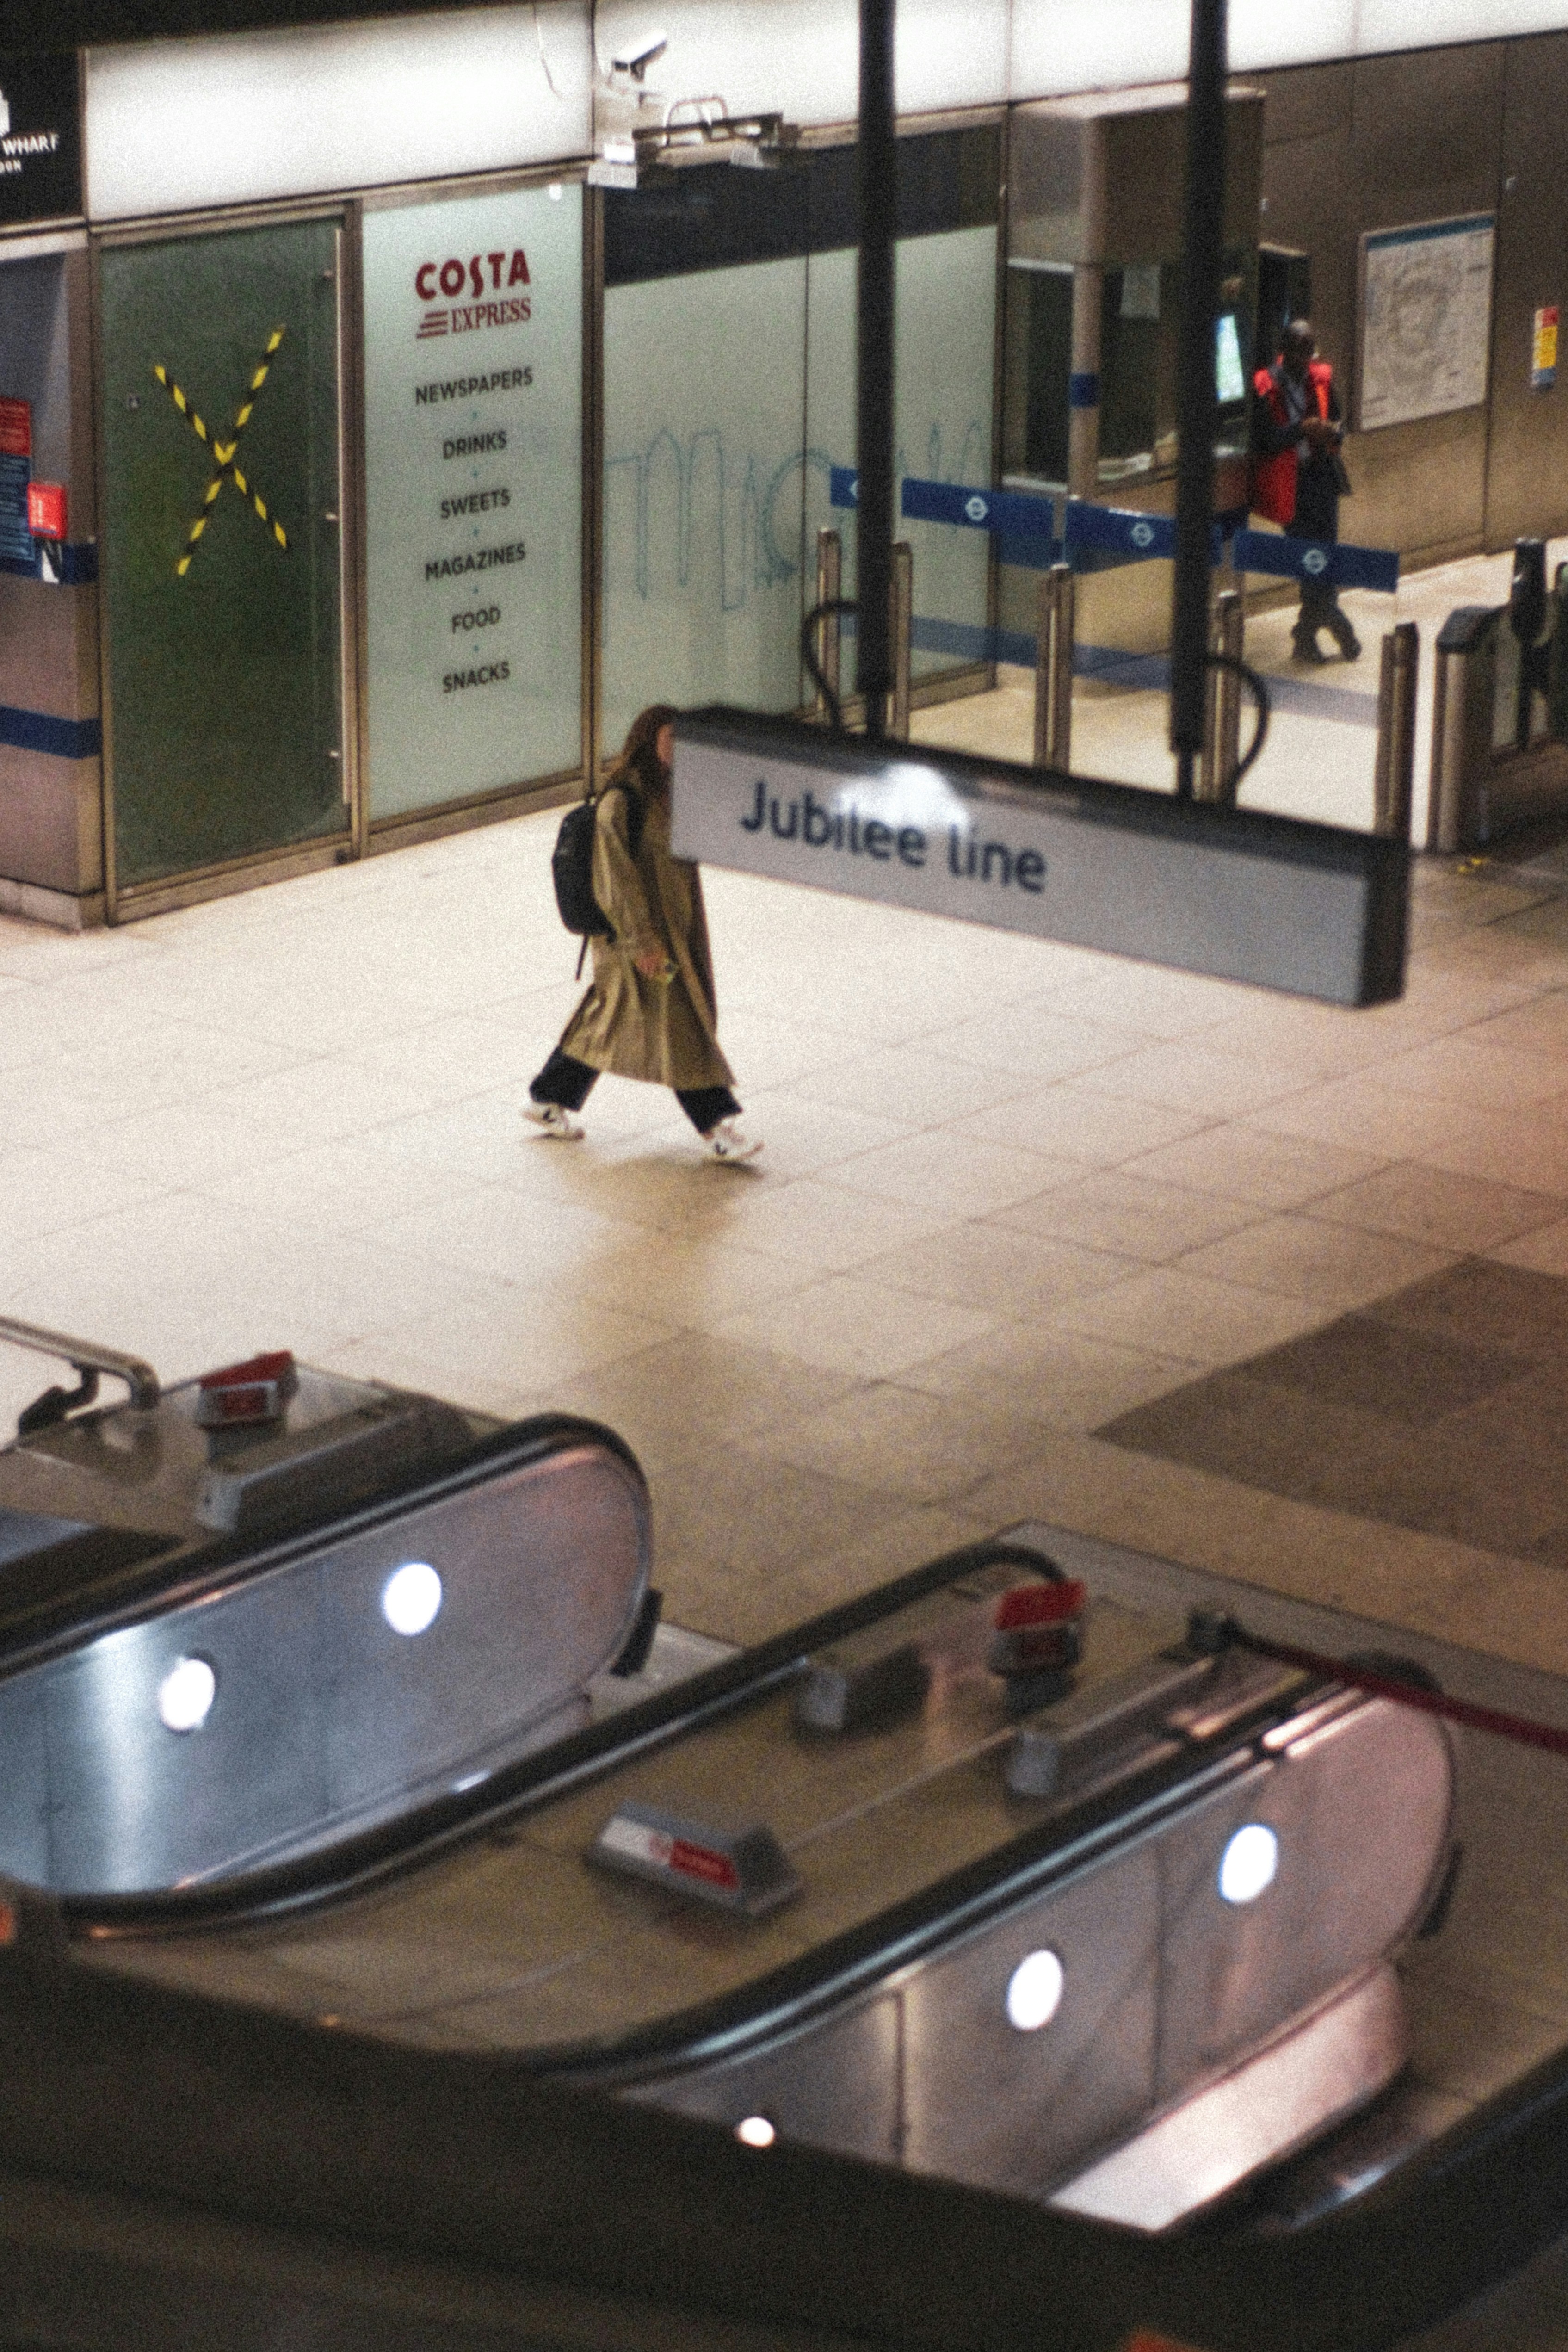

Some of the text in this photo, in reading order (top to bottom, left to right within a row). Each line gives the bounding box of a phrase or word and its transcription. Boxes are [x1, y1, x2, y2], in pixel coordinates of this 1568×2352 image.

[2, 133, 59, 156] WHARF
[415, 249, 531, 300] COSTA
[451, 297, 531, 333] EXPRESS
[415, 367, 533, 406] NEWSPAPERS
[443, 430, 507, 460] DRINKS
[440, 489, 512, 519] SWEETS
[425, 542, 526, 581] MAGAZINES
[451, 606, 501, 634] FOOD
[443, 662, 510, 693] SNACKS
[740, 780, 1048, 893] Jubilee line
